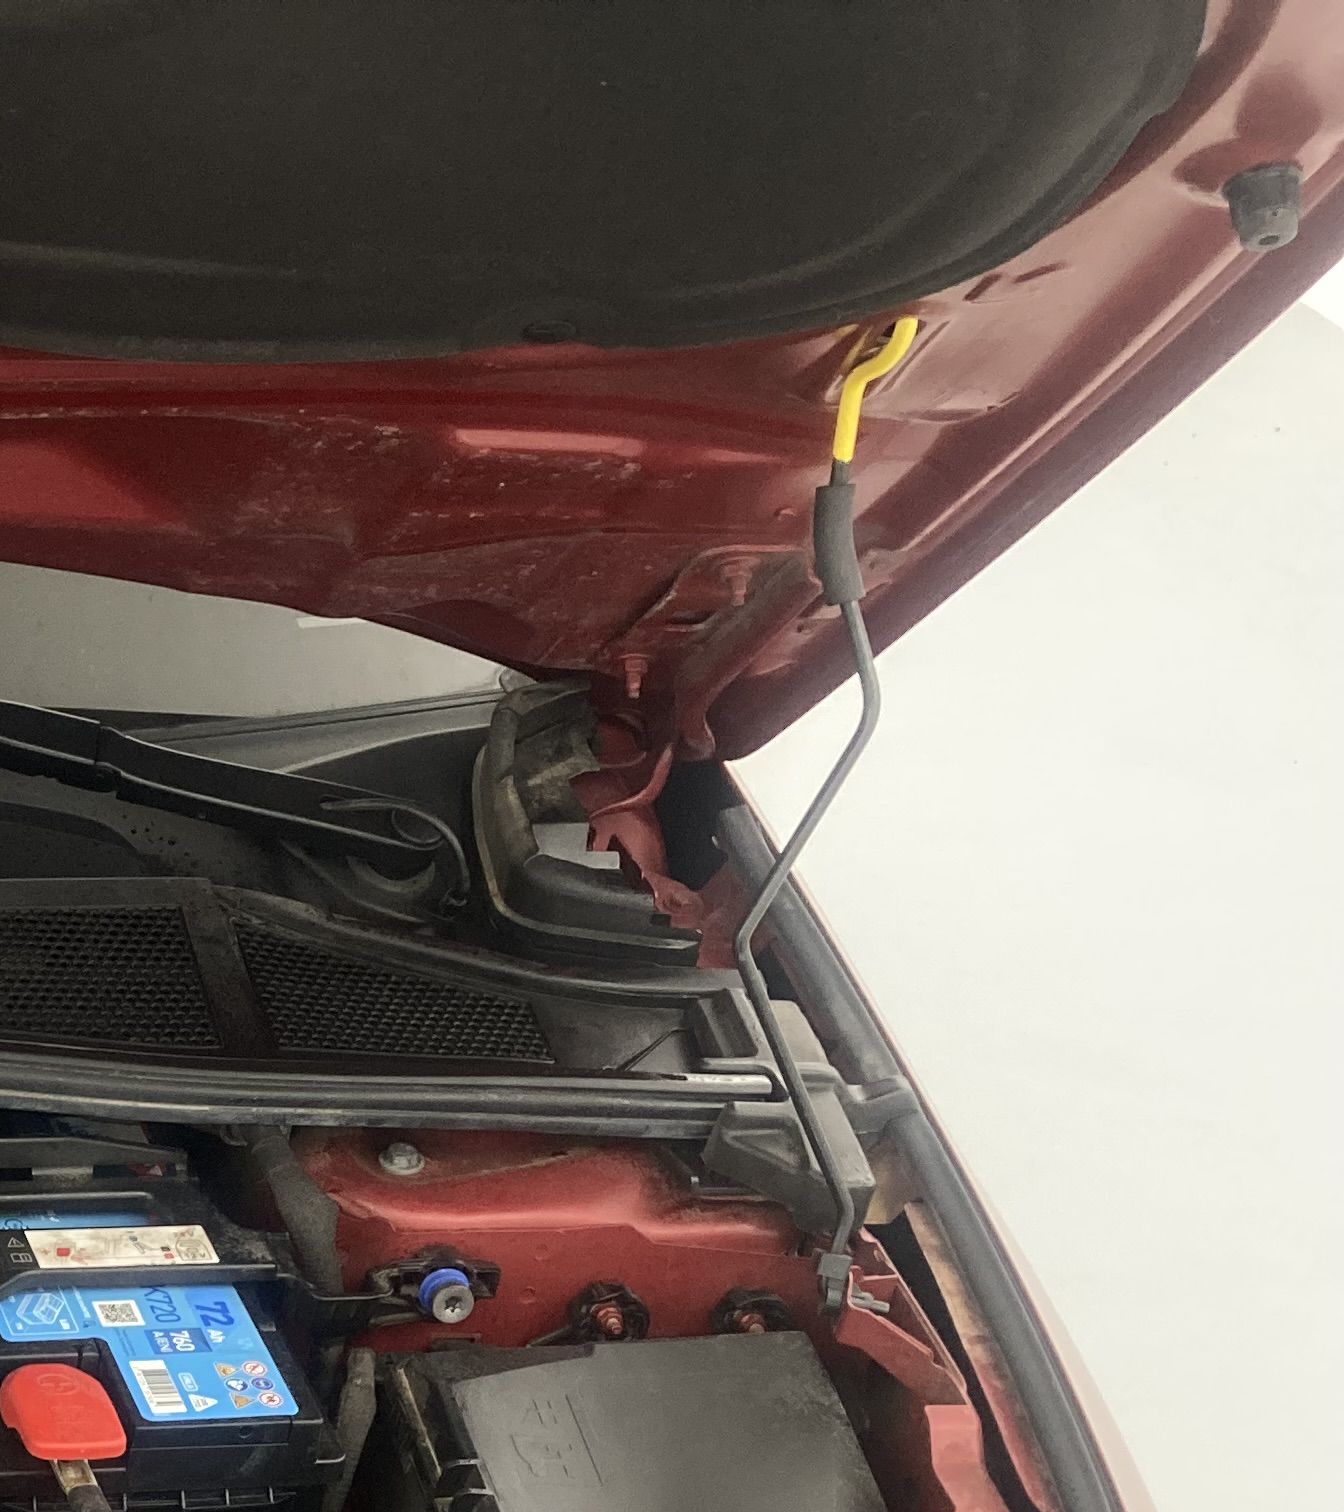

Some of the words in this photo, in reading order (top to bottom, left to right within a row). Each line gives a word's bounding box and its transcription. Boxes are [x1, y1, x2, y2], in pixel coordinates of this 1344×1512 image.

[194, 1301, 235, 1327] 72
[169, 1330, 195, 1352] 760
[206, 1328, 226, 1344] Ah
